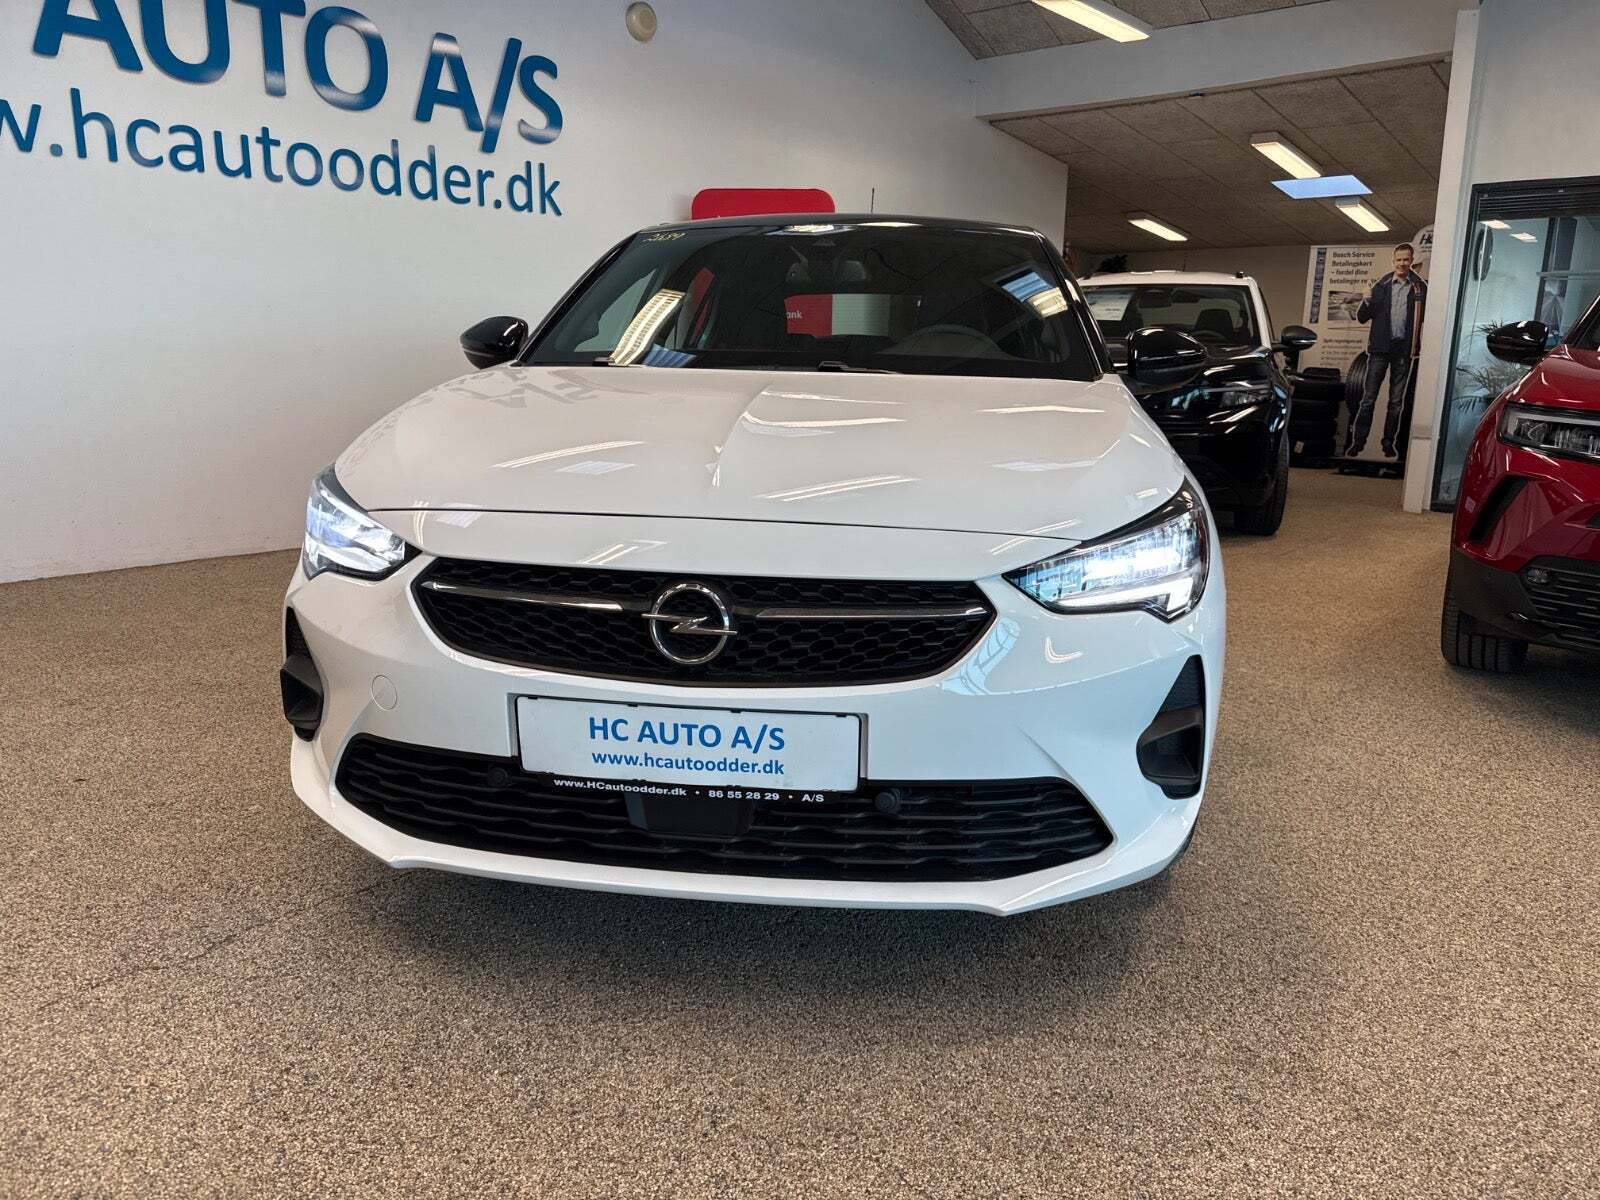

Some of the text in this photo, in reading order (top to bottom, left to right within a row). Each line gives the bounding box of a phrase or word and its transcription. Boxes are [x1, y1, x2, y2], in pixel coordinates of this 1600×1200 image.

[33, 0, 563, 153] AUTO A/S
[589, 716, 786, 754] HC AUTO A/S
[591, 752, 785, 775] www.hcautoodder.dk
[553, 778, 825, 802] www.HCautoodder.dk 86 55 28 29 A/S
